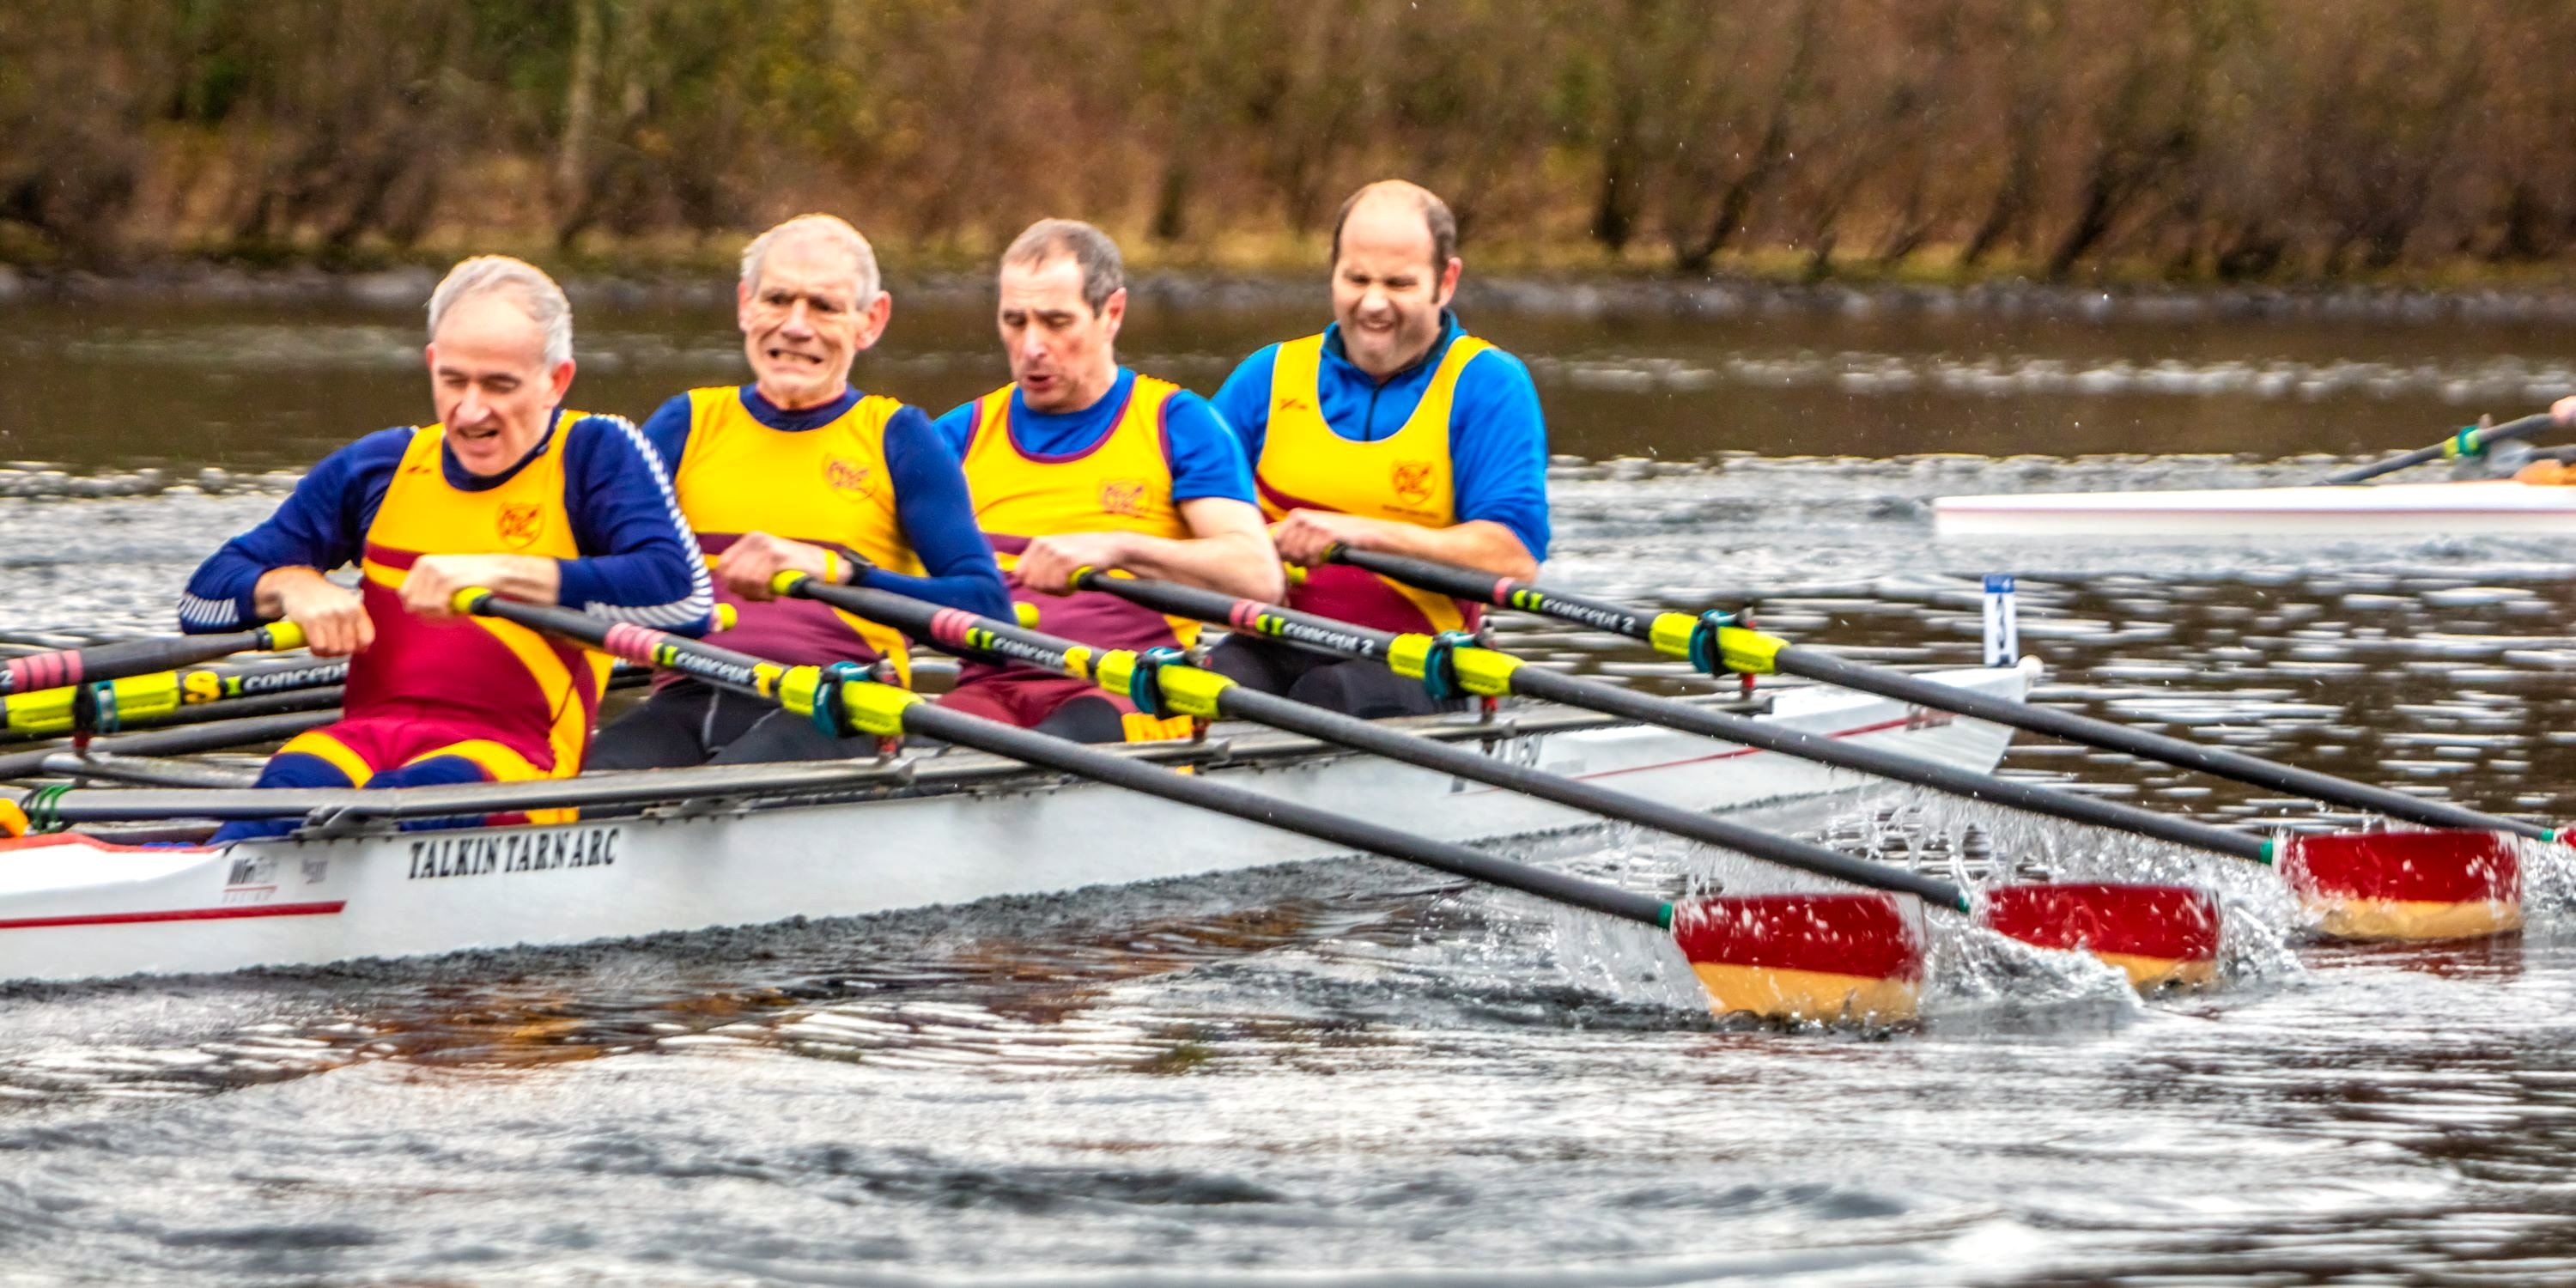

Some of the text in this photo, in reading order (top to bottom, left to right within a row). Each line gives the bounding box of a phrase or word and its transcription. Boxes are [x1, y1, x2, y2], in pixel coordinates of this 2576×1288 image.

[1543, 599, 1636, 633] concept 2
[1284, 623, 1374, 654] concept 2
[408, 827, 620, 878] TALKIN TARN ARC
